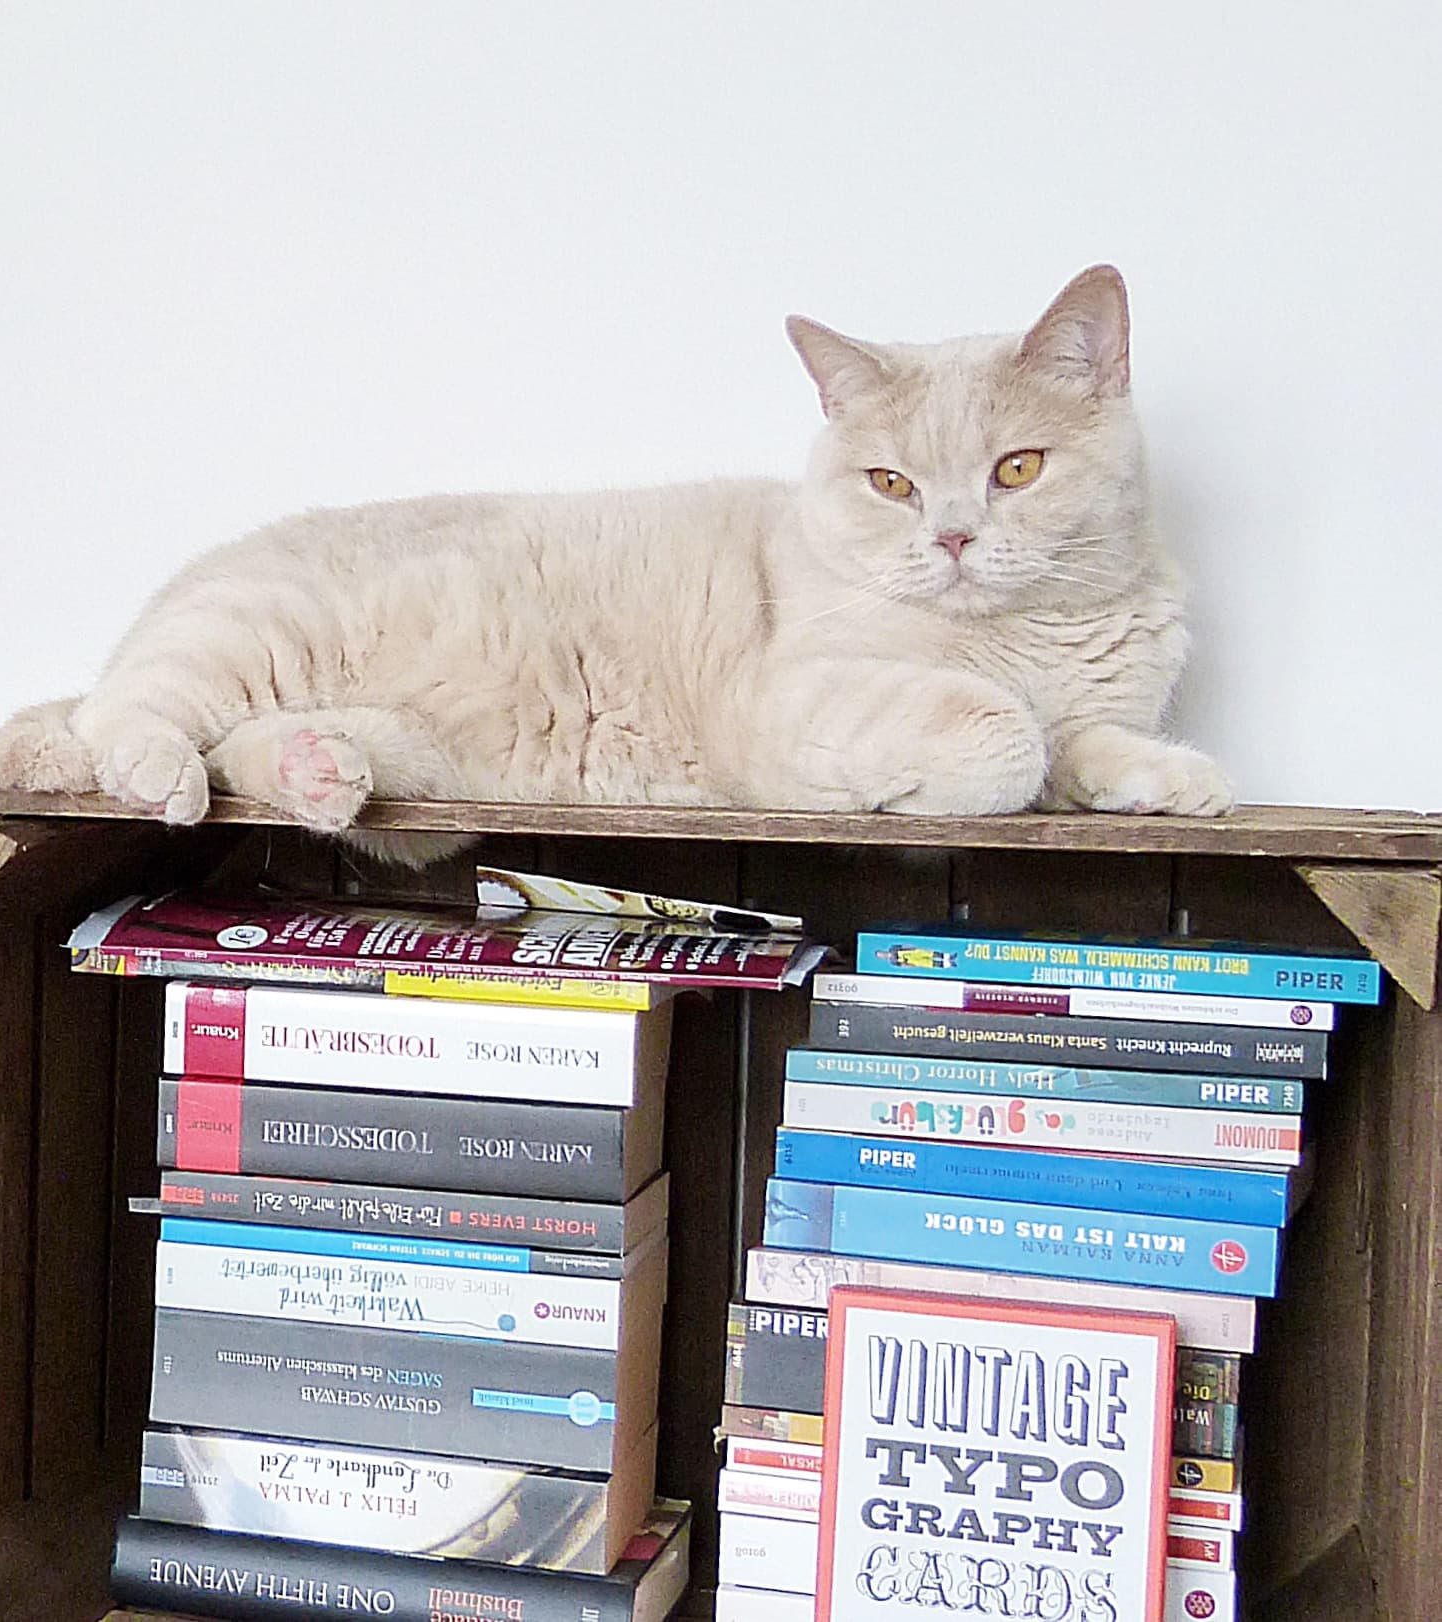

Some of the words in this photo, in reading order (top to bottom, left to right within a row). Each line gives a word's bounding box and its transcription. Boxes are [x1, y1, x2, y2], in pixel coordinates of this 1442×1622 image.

[964, 943, 990, 960] DU?
[994, 945, 1046, 963] KANNST
[1050, 947, 1078, 965] WAS
[1084, 950, 1169, 970] SCHIMMELN.
[1173, 955, 1210, 974] KANN
[1214, 957, 1249, 976] BROT
[1031, 966, 1103, 988] WILMSDORFF
[1108, 972, 1134, 988] VON
[1138, 974, 1176, 990] JENKE
[1276, 970, 1343, 991] PIPER
[191, 1023, 239, 1040] Knaur.
[261, 1025, 439, 1059] TODESBRÄUTE
[893, 1025, 946, 1040] gesucht
[949, 1028, 1024, 1045] verzweifelt
[1027, 1033, 1064, 1049] Klaus
[466, 1041, 521, 1063] ROSE
[1068, 1035, 1107, 1050] Santa
[1116, 1038, 1166, 1054] Knecht
[1167, 1040, 1232, 1058] Ruprecht
[527, 1046, 599, 1069] KAREN
[815, 1059, 920, 1082] Christmas
[927, 1067, 997, 1088] Horror
[1200, 1082, 1269, 1105] PIPER
[1034, 1110, 1076, 1135] das
[262, 1119, 433, 1156] TODESSCHREI
[459, 1137, 514, 1159] ROSE
[1214, 1124, 1277, 1151] DUMONT
[520, 1141, 592, 1164] KAREN
[859, 1148, 916, 1169] PIPER
[253, 1191, 284, 1213] Zeit
[289, 1195, 311, 1215] die
[312, 1198, 335, 1212] mir
[339, 1196, 380, 1223] fehlt
[382, 1202, 413, 1225] Eile
[415, 1206, 442, 1227] Für
[468, 1211, 525, 1230] EVERS
[924, 1212, 1005, 1236] GLÜCK
[532, 1216, 597, 1236] HORST
[1016, 1221, 1063, 1241] DAS
[1074, 1227, 1114, 1247] IST
[1124, 1231, 1186, 1253] KALT
[1123, 1250, 1184, 1267] ANNA
[221, 1259, 343, 1292] überbewertet
[349, 1265, 407, 1293] völlig
[414, 1276, 456, 1294] ABIDI
[278, 1287, 323, 1311] wird
[463, 1281, 510, 1298] HEIKE
[326, 1293, 425, 1322] Wahrheit
[552, 1303, 606, 1323] KNAUR
[755, 1310, 828, 1340] PIPER
[217, 1351, 282, 1372] Altertums
[286, 1357, 357, 1380] klassischen
[361, 1366, 383, 1382] des
[387, 1369, 443, 1389] SAGEN
[300, 1386, 372, 1408] SCHWAB
[868, 1335, 1128, 1450] VINTAGE
[376, 1394, 442, 1415] GUSTAV
[260, 1453, 298, 1480] Zeit
[303, 1456, 321, 1473] der
[866, 1437, 1124, 1510] TYPO
[326, 1458, 421, 1493] Landkarte
[428, 1469, 452, 1490] Die
[258, 1482, 330, 1505] PALMA
[339, 1491, 352, 1508] J.
[361, 1494, 417, 1518] FÉLIX
[860, 1498, 1123, 1557] GRAPHY
[150, 1559, 250, 1594] AVENUE
[856, 1543, 1118, 1622] CARDS
[256, 1573, 327, 1606] FIFTH
[337, 1583, 395, 1613] ONE
[428, 1587, 524, 1620] Bushnell
